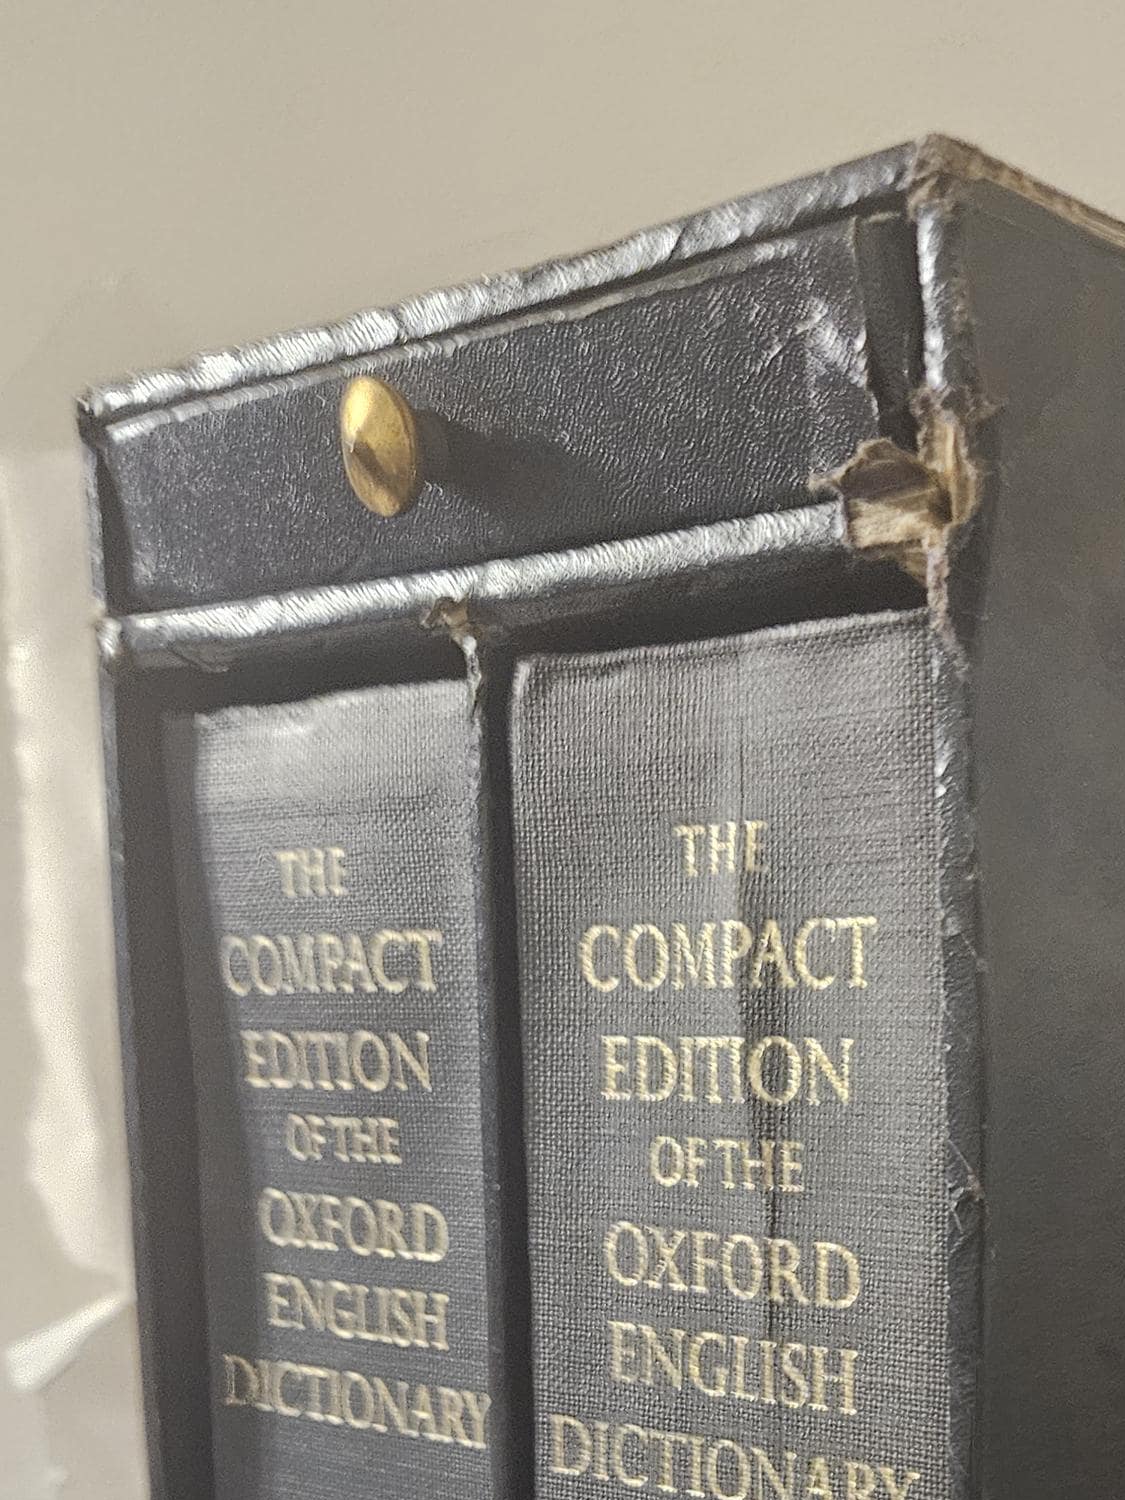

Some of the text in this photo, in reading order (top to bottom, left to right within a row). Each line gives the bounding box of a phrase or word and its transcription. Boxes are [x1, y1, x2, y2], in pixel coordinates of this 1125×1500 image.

[277, 847, 345, 898] THE
[674, 821, 768, 876] THE
[221, 929, 442, 996] COMPACT
[579, 916, 877, 992] COMPACT
[241, 1030, 433, 1092] EDITION
[600, 1036, 854, 1106] EDITION
[286, 1115, 402, 1164] OF THE
[650, 1136, 805, 1191] OF THE
[258, 1187, 450, 1263] OXFORD
[604, 1221, 860, 1308] OXFORD
[263, 1272, 450, 1351] ENGLISH
[224, 1354, 491, 1449] DICTIONARY
[608, 1321, 858, 1414] ENGLISH
